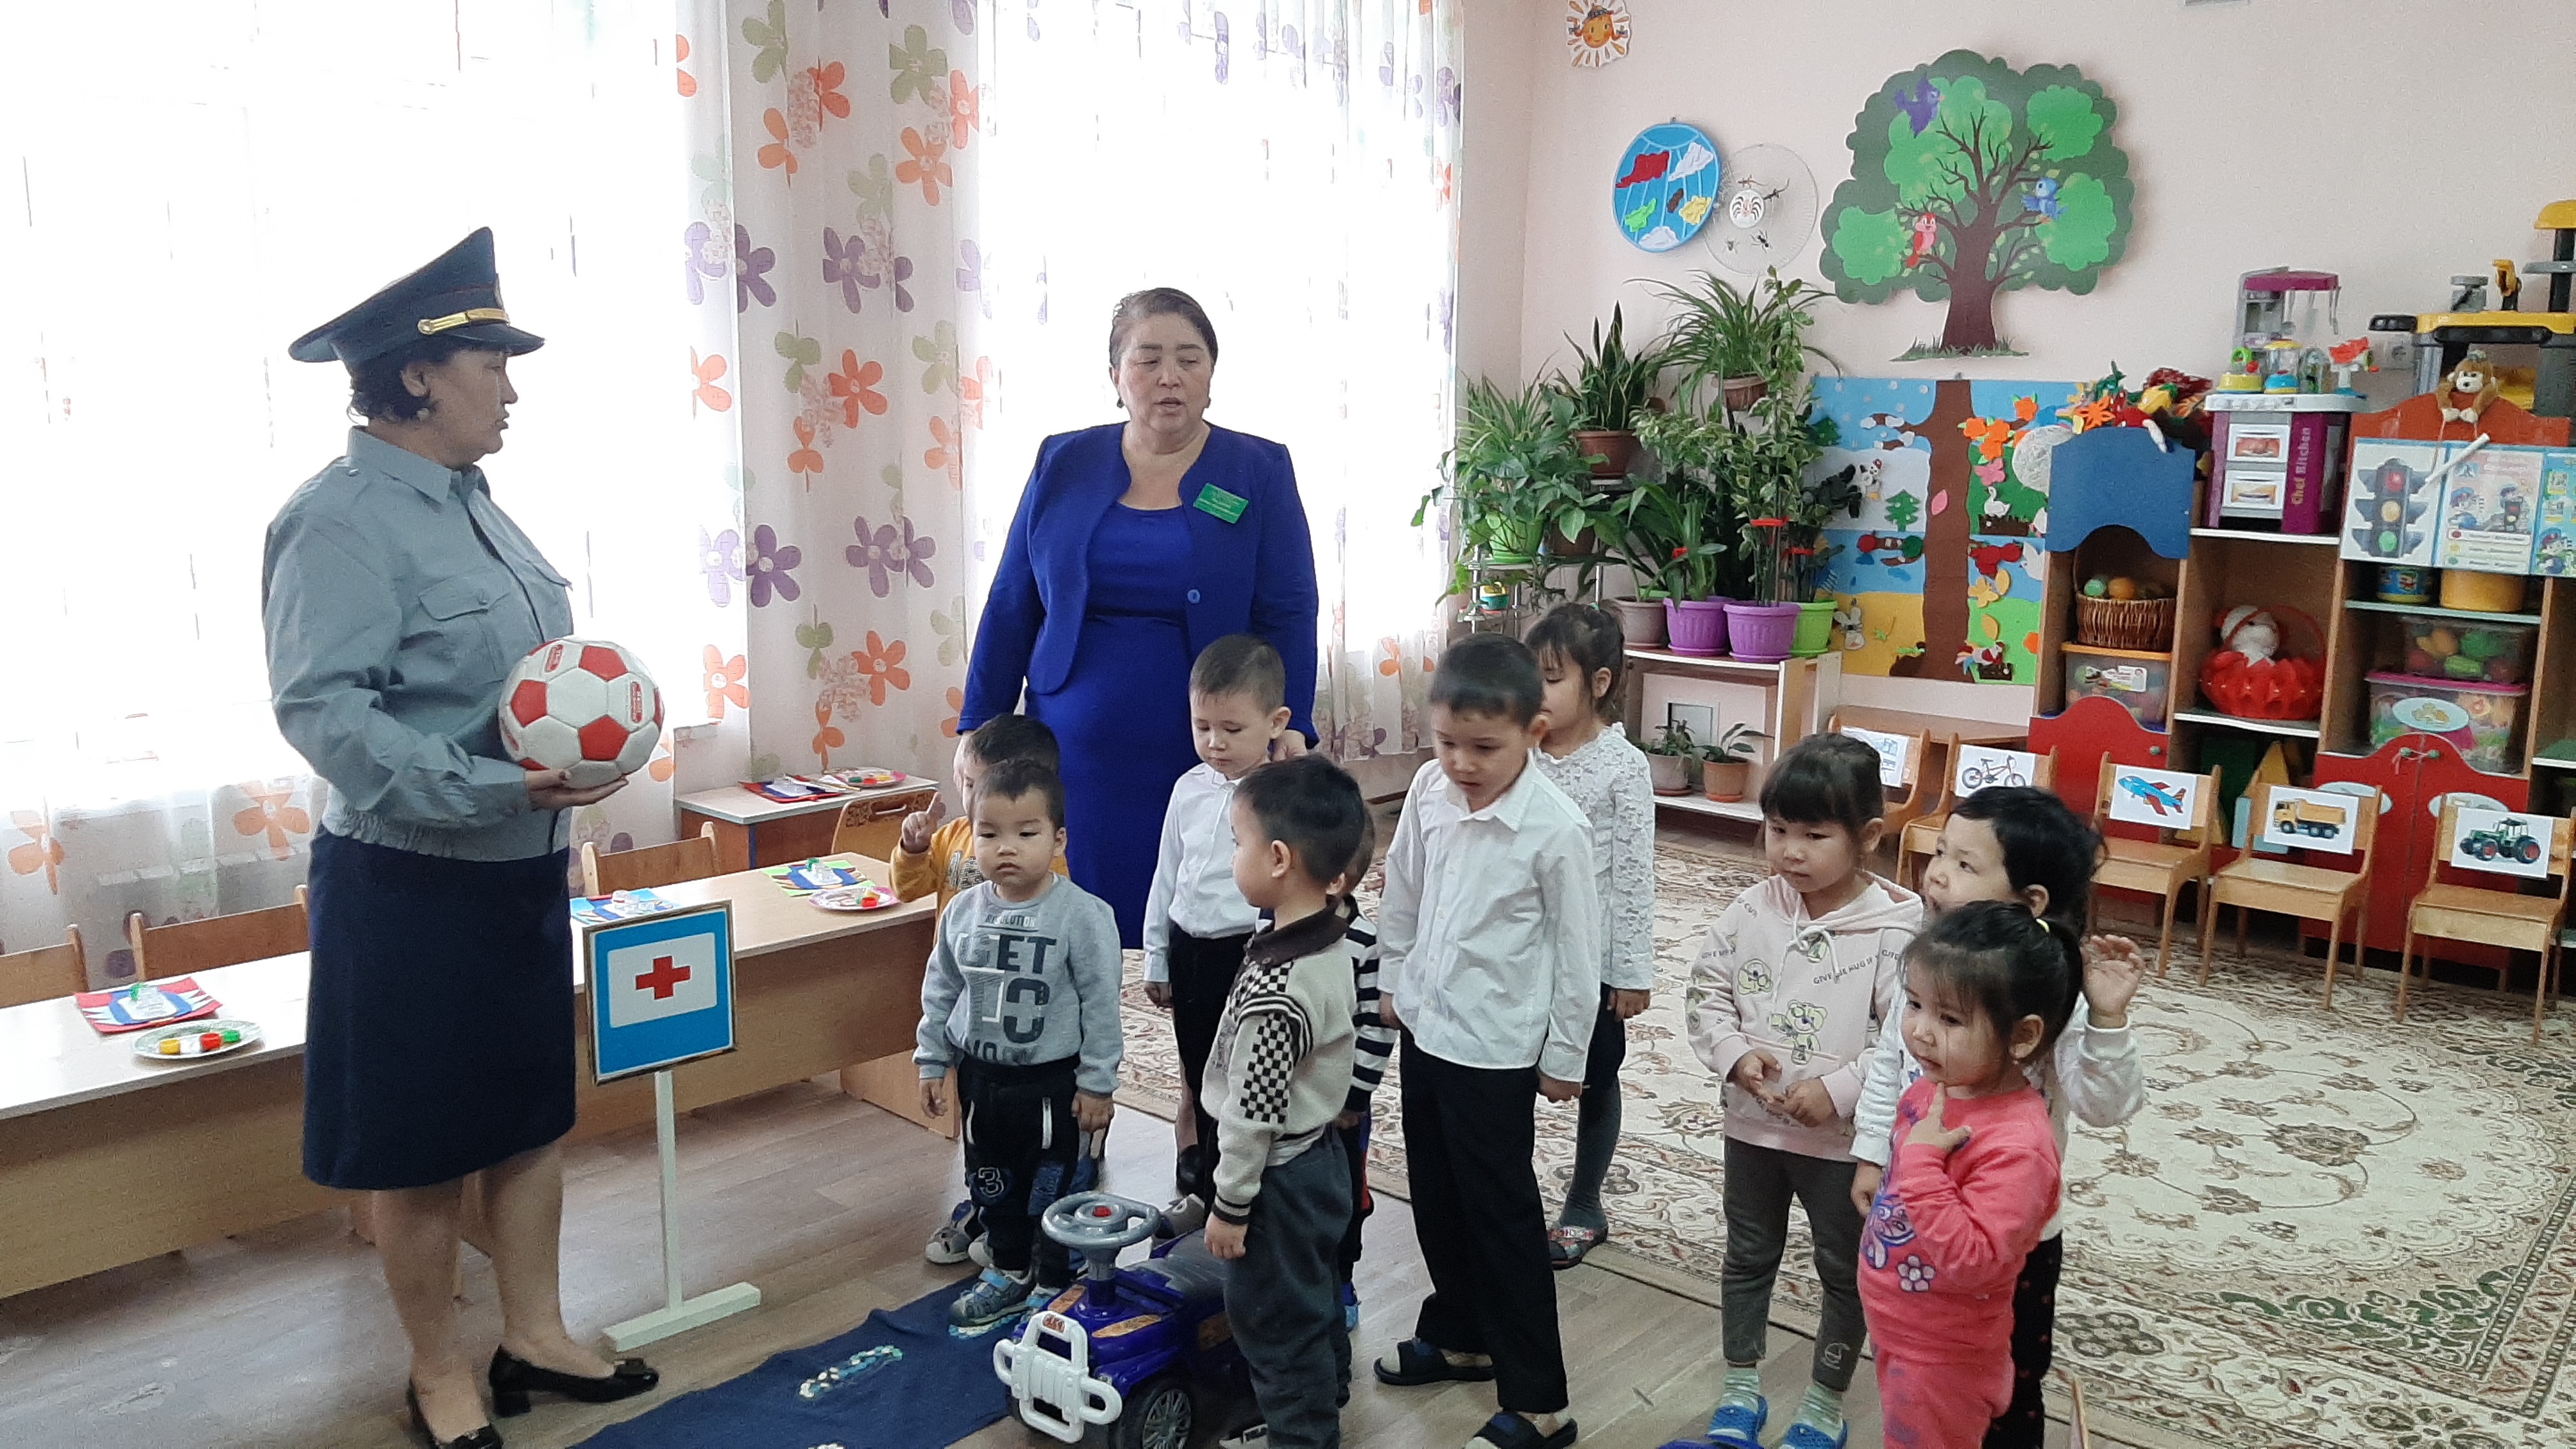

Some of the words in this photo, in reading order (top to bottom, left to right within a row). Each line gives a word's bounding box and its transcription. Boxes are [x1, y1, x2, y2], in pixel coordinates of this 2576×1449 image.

[2296, 427, 2311, 474] Kitchen
[2291, 477, 2306, 505] Chef
[985, 914, 1038, 928] REOLUTION
[958, 933, 1057, 975] GET
[1848, 960, 1866, 973] HUG
[978, 1167, 1004, 1197] 3
